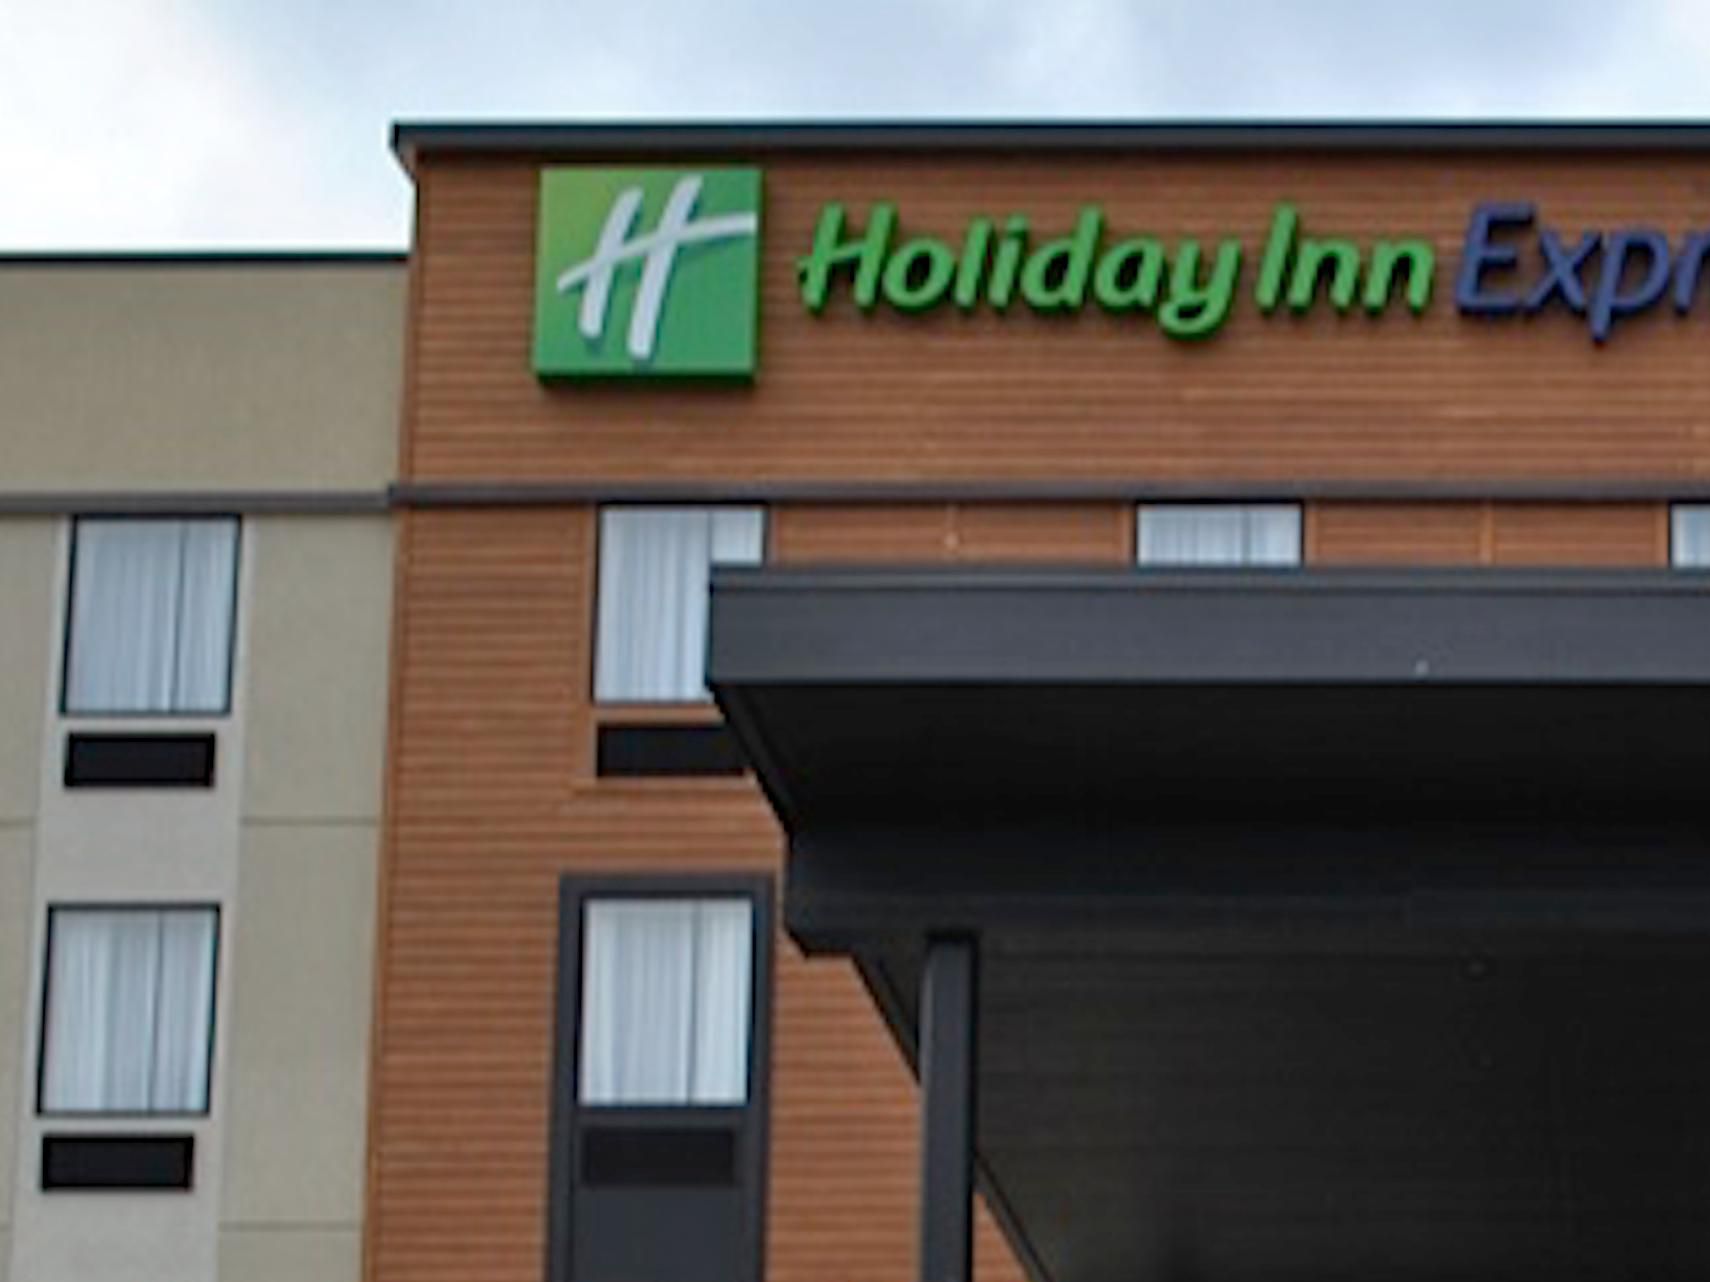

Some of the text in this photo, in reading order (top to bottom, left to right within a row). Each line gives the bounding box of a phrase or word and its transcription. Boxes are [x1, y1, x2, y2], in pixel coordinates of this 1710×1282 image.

[557, 174, 757, 361] H
[797, 202, 1242, 338] Holiday
[1255, 202, 1435, 314] Inn
